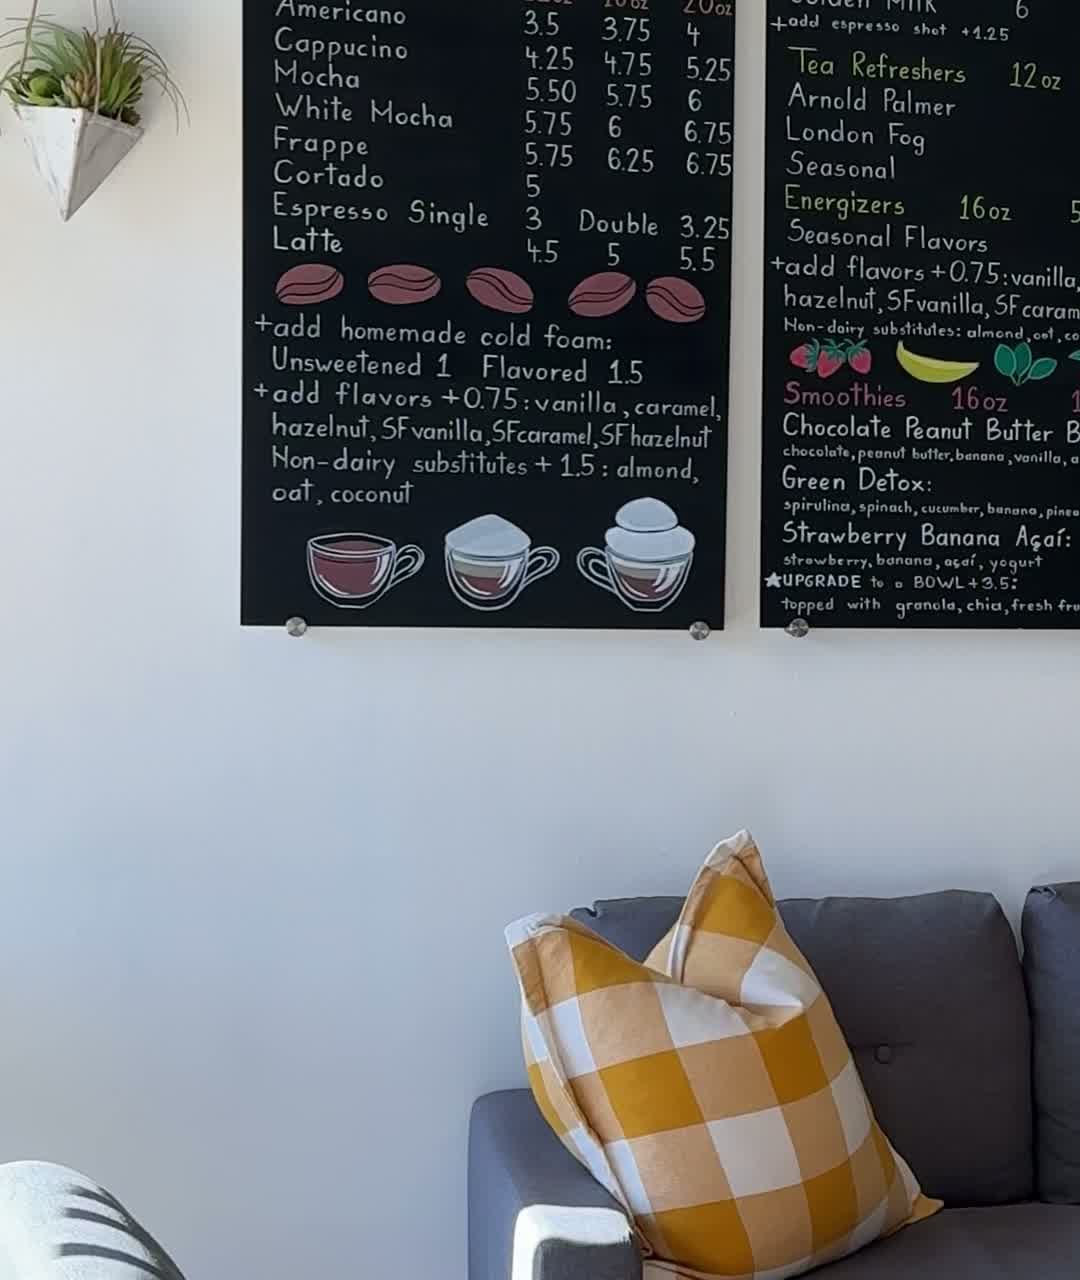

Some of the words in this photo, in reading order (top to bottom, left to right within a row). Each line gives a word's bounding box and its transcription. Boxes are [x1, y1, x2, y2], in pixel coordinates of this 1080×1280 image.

[524, 10, 559, 36] 3.5
[601, 17, 650, 42] 3.75
[687, 22, 700, 47] 4
[275, 26, 407, 62] Cappucino
[526, 45, 573, 70] 4.25
[605, 51, 651, 76] 4.75
[687, 56, 731, 82] 5.25
[787, 46, 834, 75] Tea
[853, 51, 966, 83] Refreshers
[788, 82, 866, 111] Arnold
[884, 88, 956, 116] Palmer
[274, 125, 368, 162] Frappe
[526, 142, 573, 167] 5.75
[608, 147, 654, 172] 6.25
[687, 152, 731, 176] 6.75
[786, 115, 873, 144] London
[888, 122, 924, 156] Fog
[274, 191, 388, 226] Espresso
[408, 200, 488, 233] Single
[526, 206, 542, 230] 3
[579, 209, 658, 236] Double
[680, 214, 729, 239] 3.25
[785, 184, 904, 220] Energizers
[273, 225, 343, 253] Latte
[528, 238, 559, 263] 4.5
[608, 242, 620, 266] 5
[680, 246, 715, 271] 5.5
[784, 381, 906, 407] Smoothies
[783, 412, 891, 438] Chocolate
[906, 416, 973, 440] Peanut
[987, 417, 1054, 442] Butter
[272, 478, 323, 506] oat,
[331, 480, 414, 504] coconut
[782, 464, 845, 490] Green
[859, 466, 931, 492] Detox:
[782, 520, 906, 551] Strawberry
[921, 523, 1000, 547] Banana
